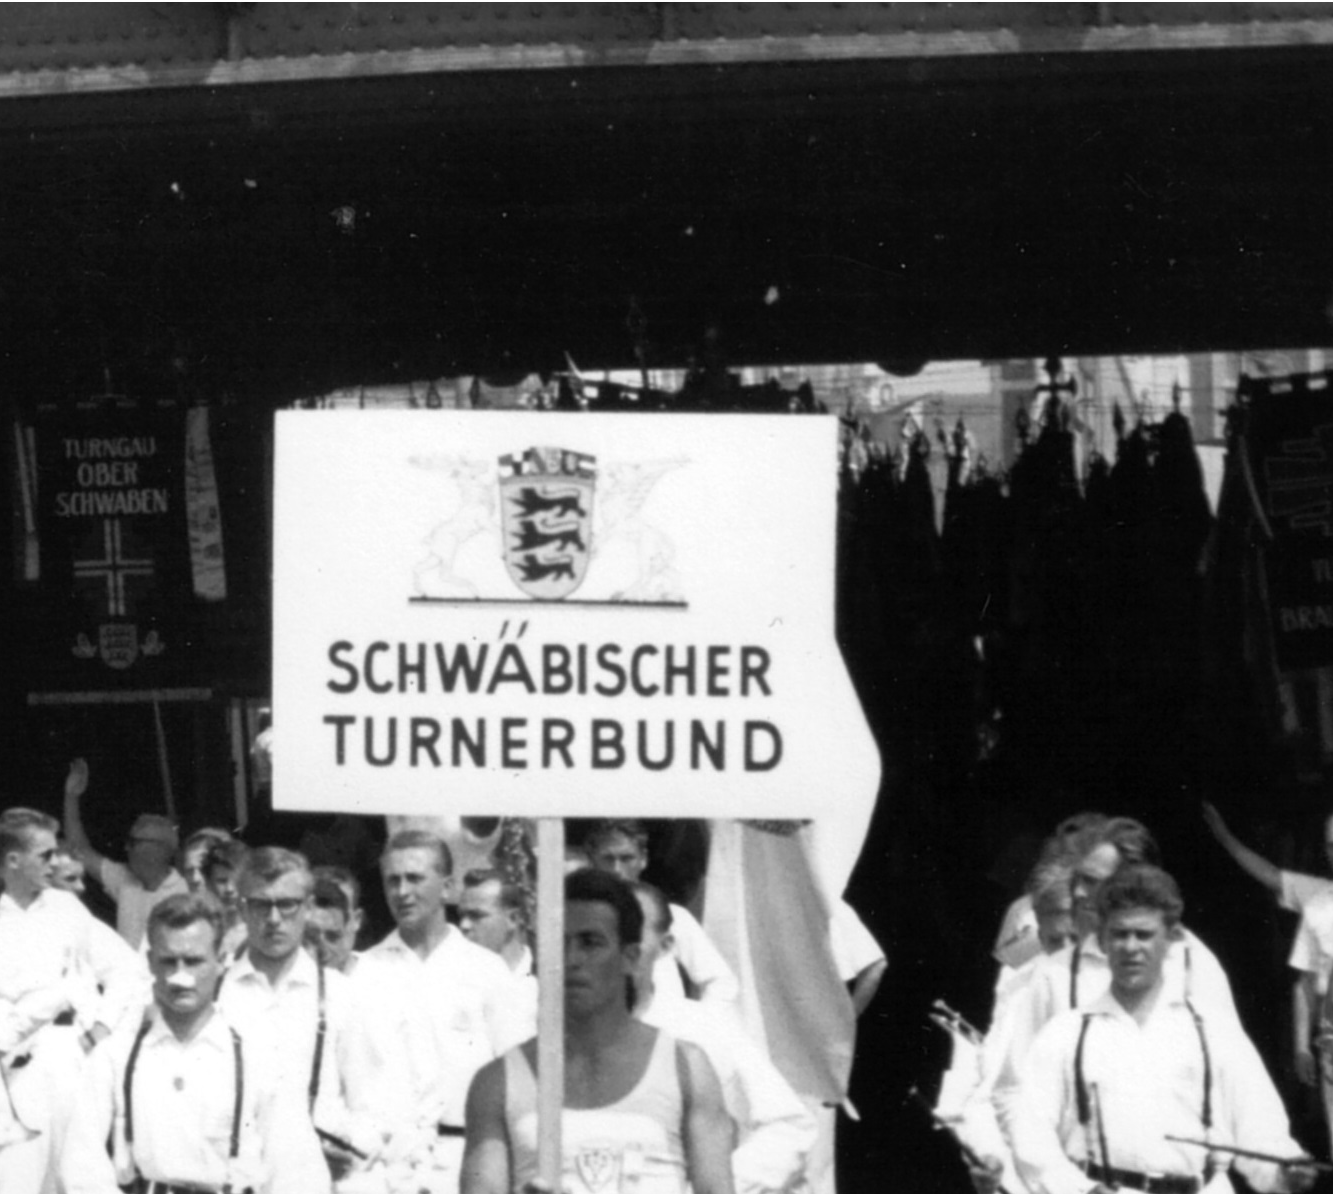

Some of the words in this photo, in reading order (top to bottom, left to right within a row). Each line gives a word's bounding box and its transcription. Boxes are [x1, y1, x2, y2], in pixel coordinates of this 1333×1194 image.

[63, 436, 157, 459] TURNGAU
[77, 461, 138, 487] OBER
[55, 488, 168, 516] SCHWABEN
[326, 620, 773, 698] SCHWÄBISCHER
[323, 715, 784, 772] TURNERBUND
